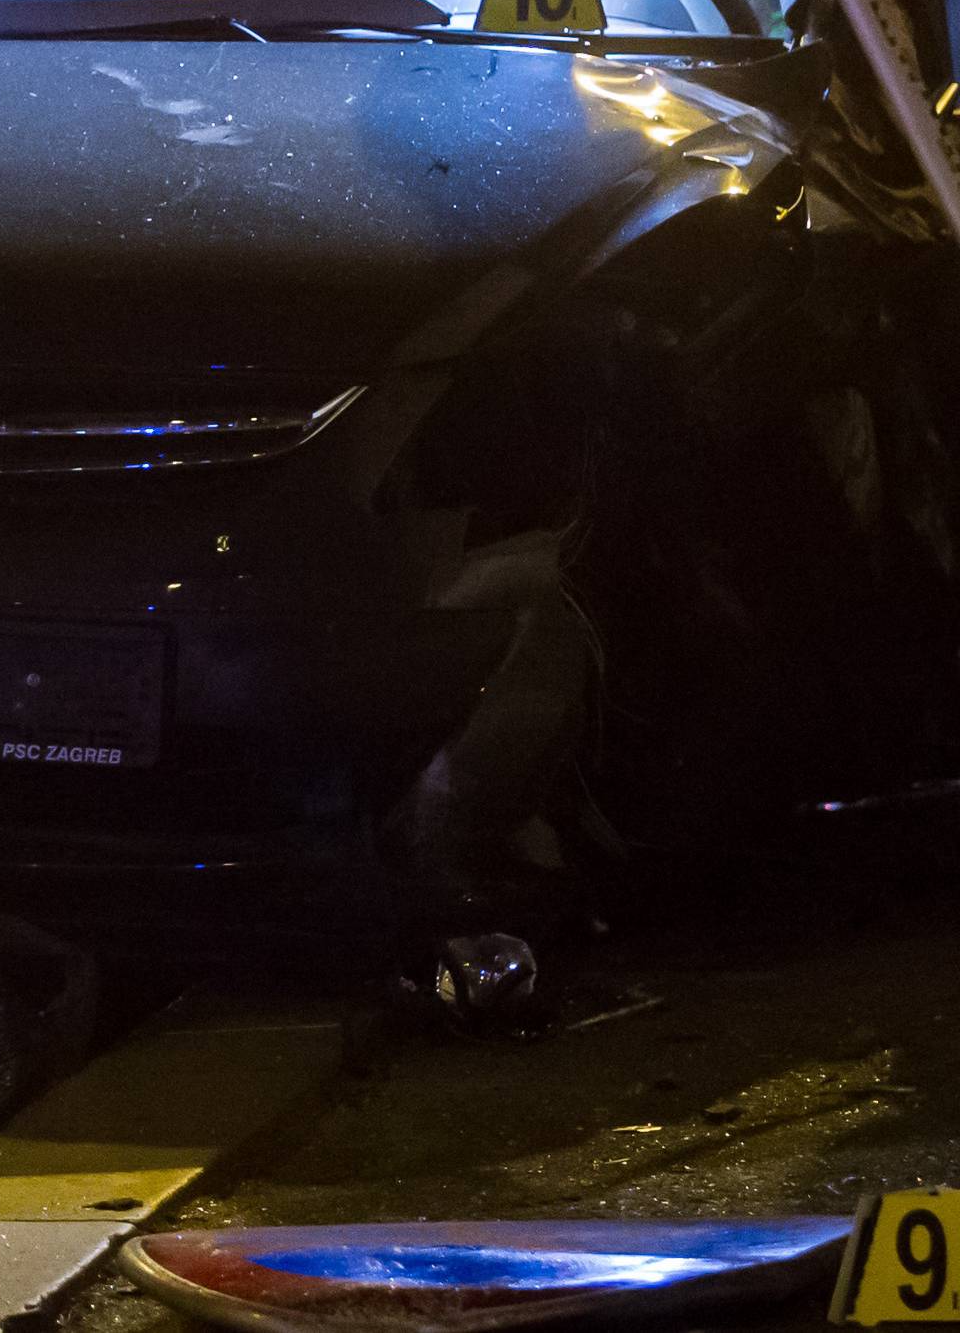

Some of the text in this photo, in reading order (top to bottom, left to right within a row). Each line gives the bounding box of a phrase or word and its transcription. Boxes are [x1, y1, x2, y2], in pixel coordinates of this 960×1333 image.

[2, 742, 123, 765] PSC ZAGREB
[896, 1209, 947, 1311] 9
